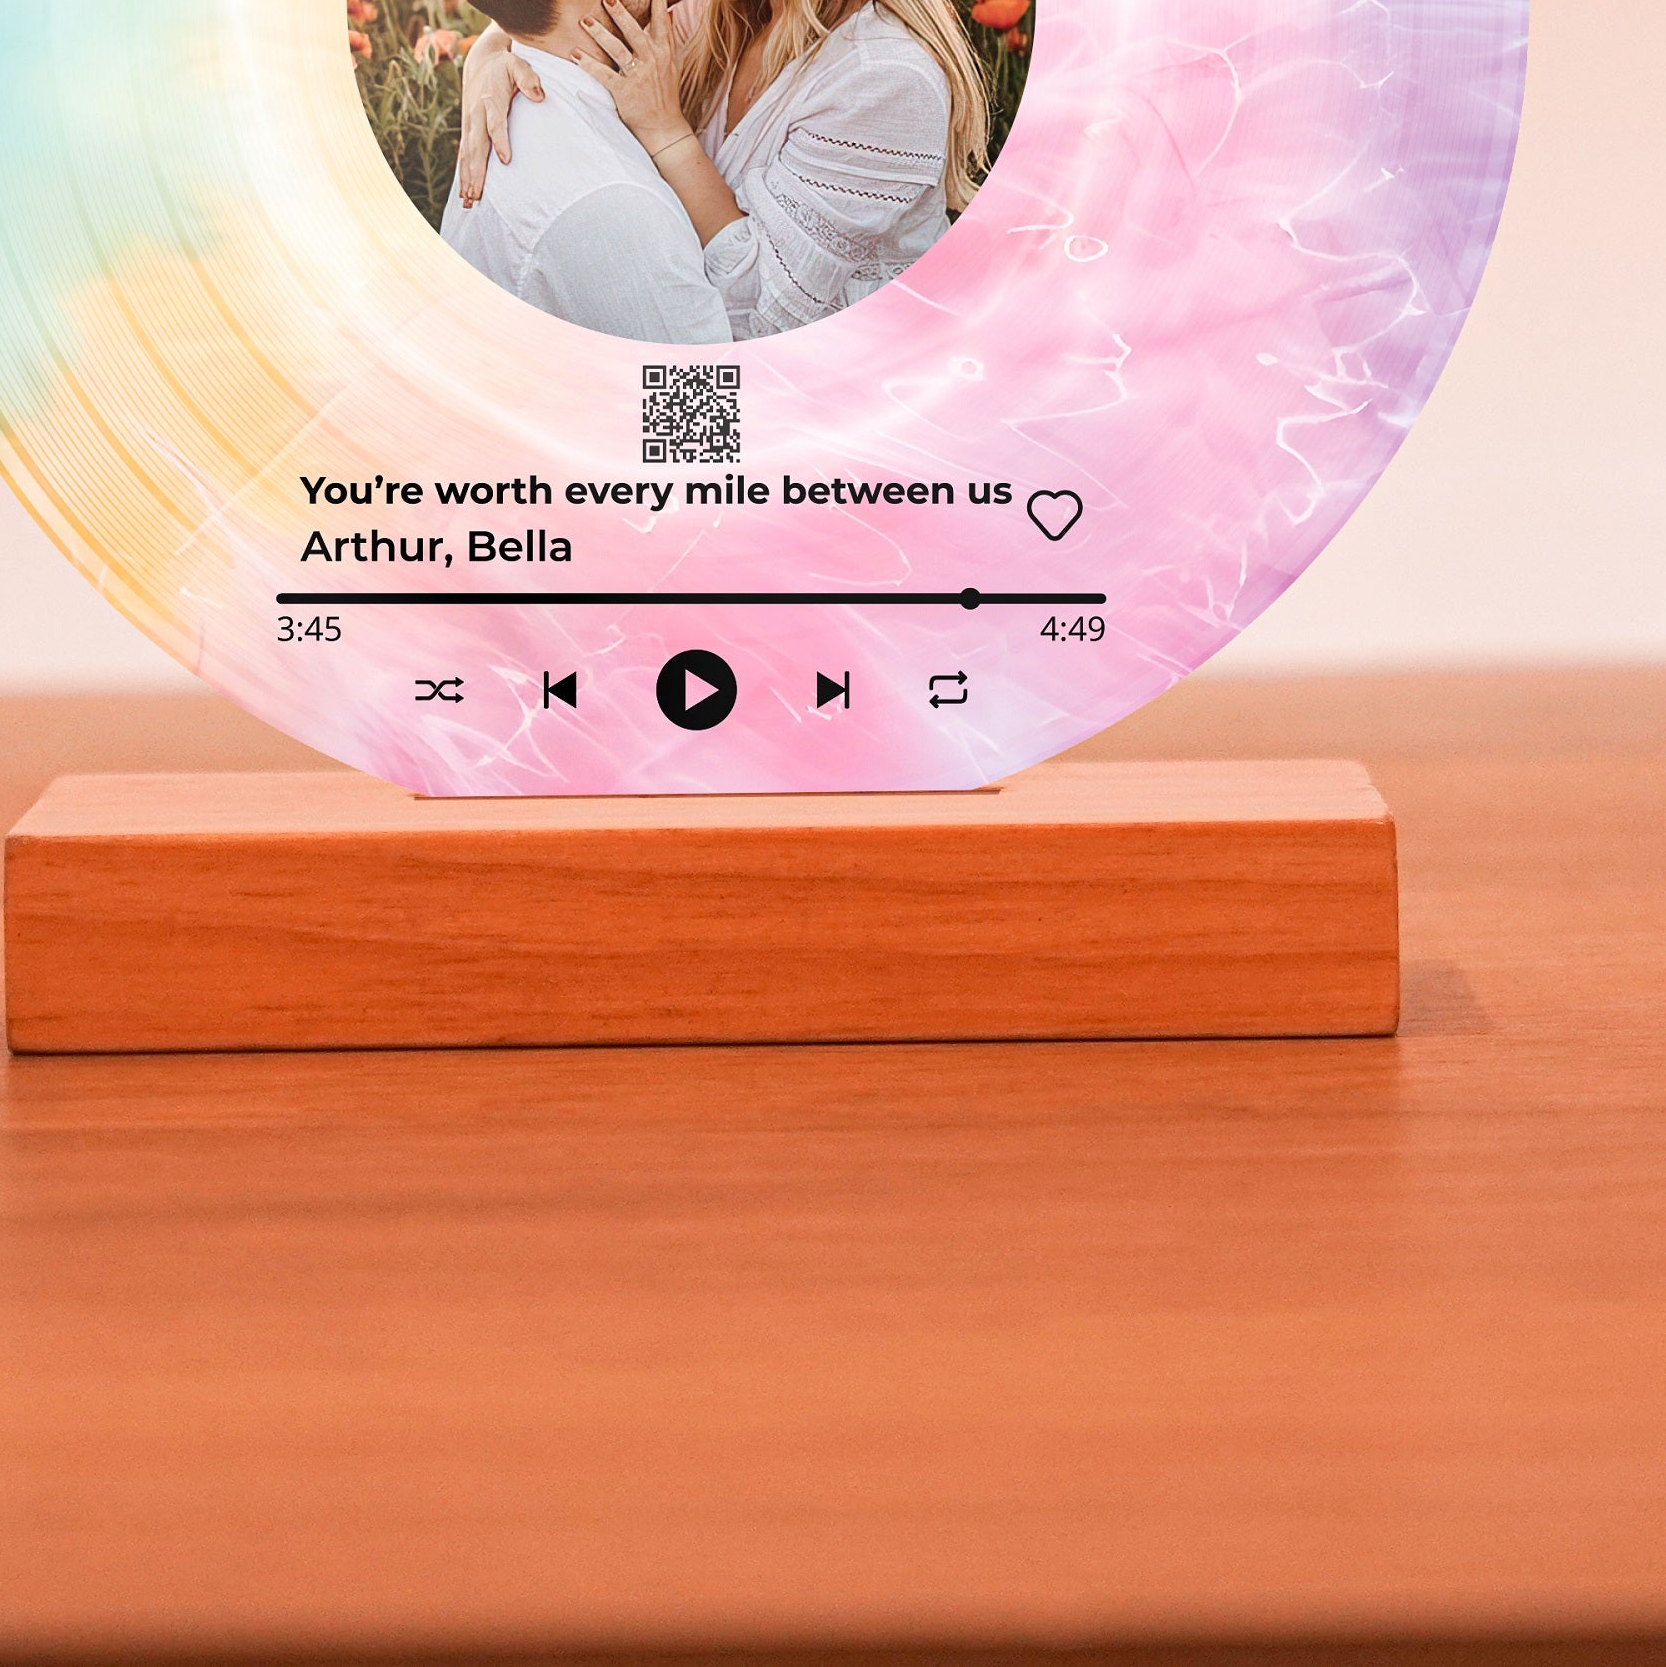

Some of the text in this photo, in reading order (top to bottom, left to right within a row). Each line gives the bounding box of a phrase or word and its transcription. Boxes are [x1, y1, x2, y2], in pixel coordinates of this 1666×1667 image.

[299, 473, 1013, 512] You’re worth every mile between us
[300, 529, 573, 569] Arthur, Bella
[277, 615, 342, 642] 3:45
[1040, 615, 1106, 642] 4:49
